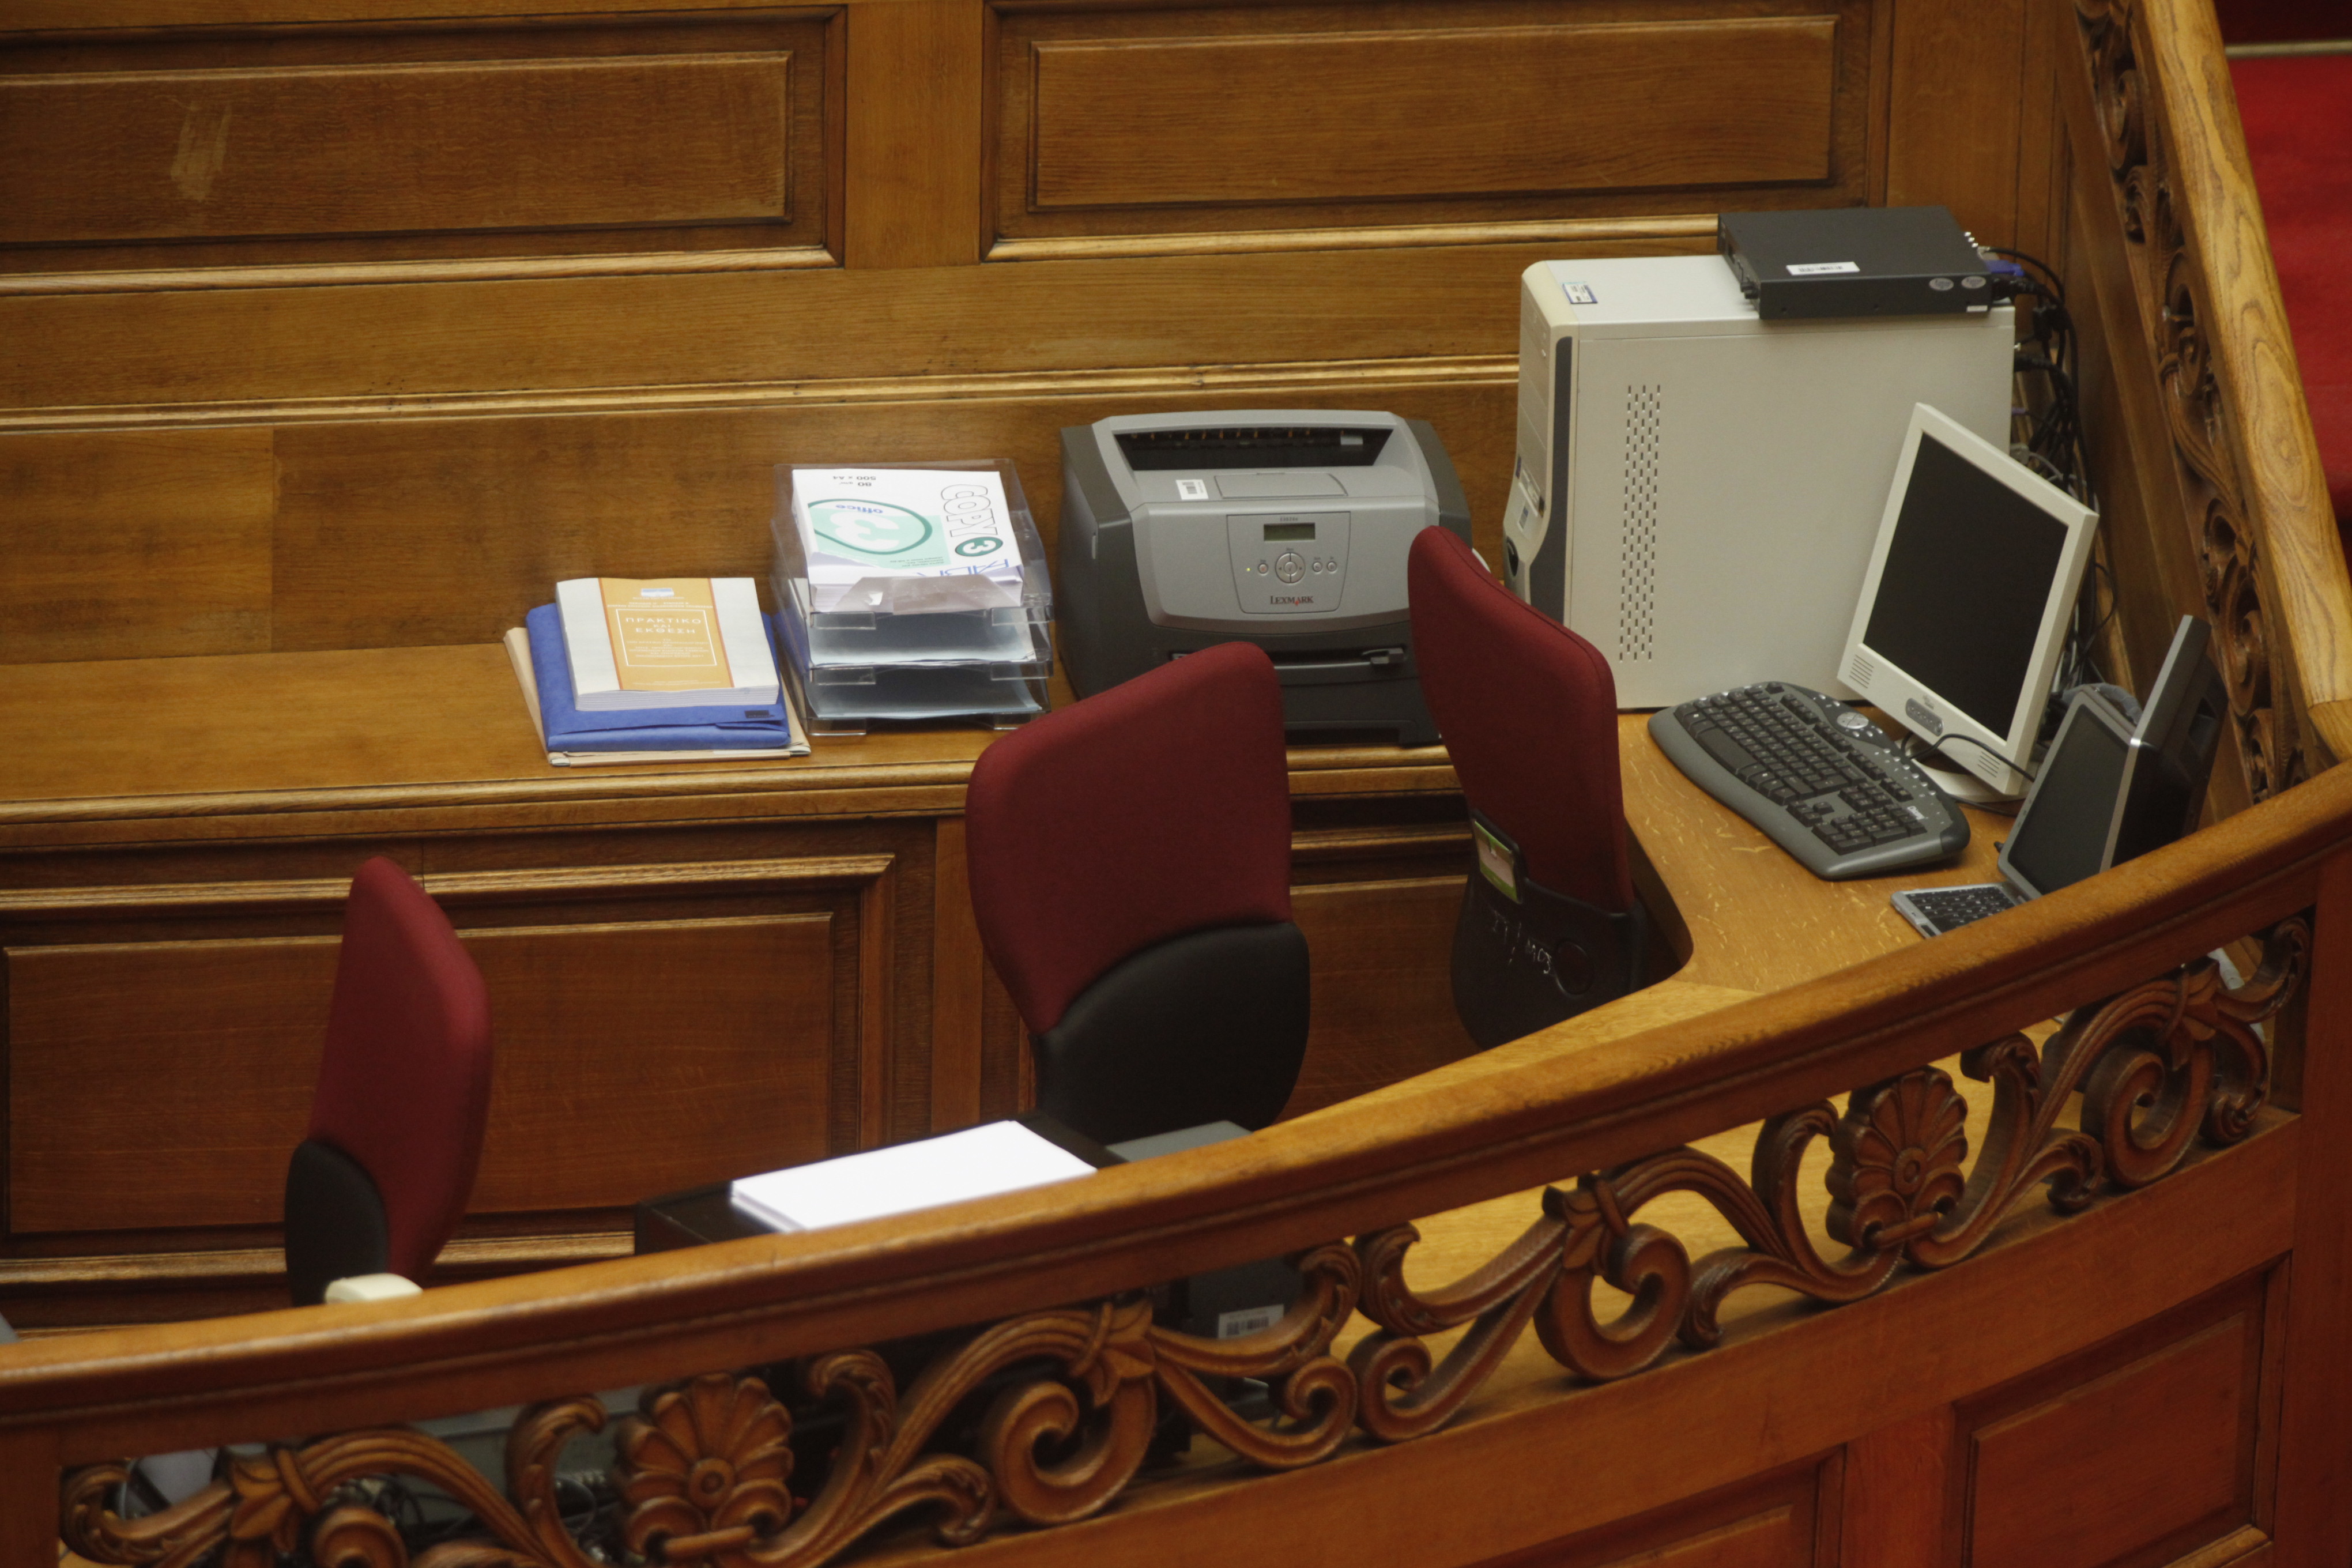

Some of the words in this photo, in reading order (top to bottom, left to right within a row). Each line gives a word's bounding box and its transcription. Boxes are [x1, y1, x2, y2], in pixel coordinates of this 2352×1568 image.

[836, 504, 883, 513] office
[941, 484, 998, 537] COPY
[1270, 595, 1314, 605] LEXMARK
